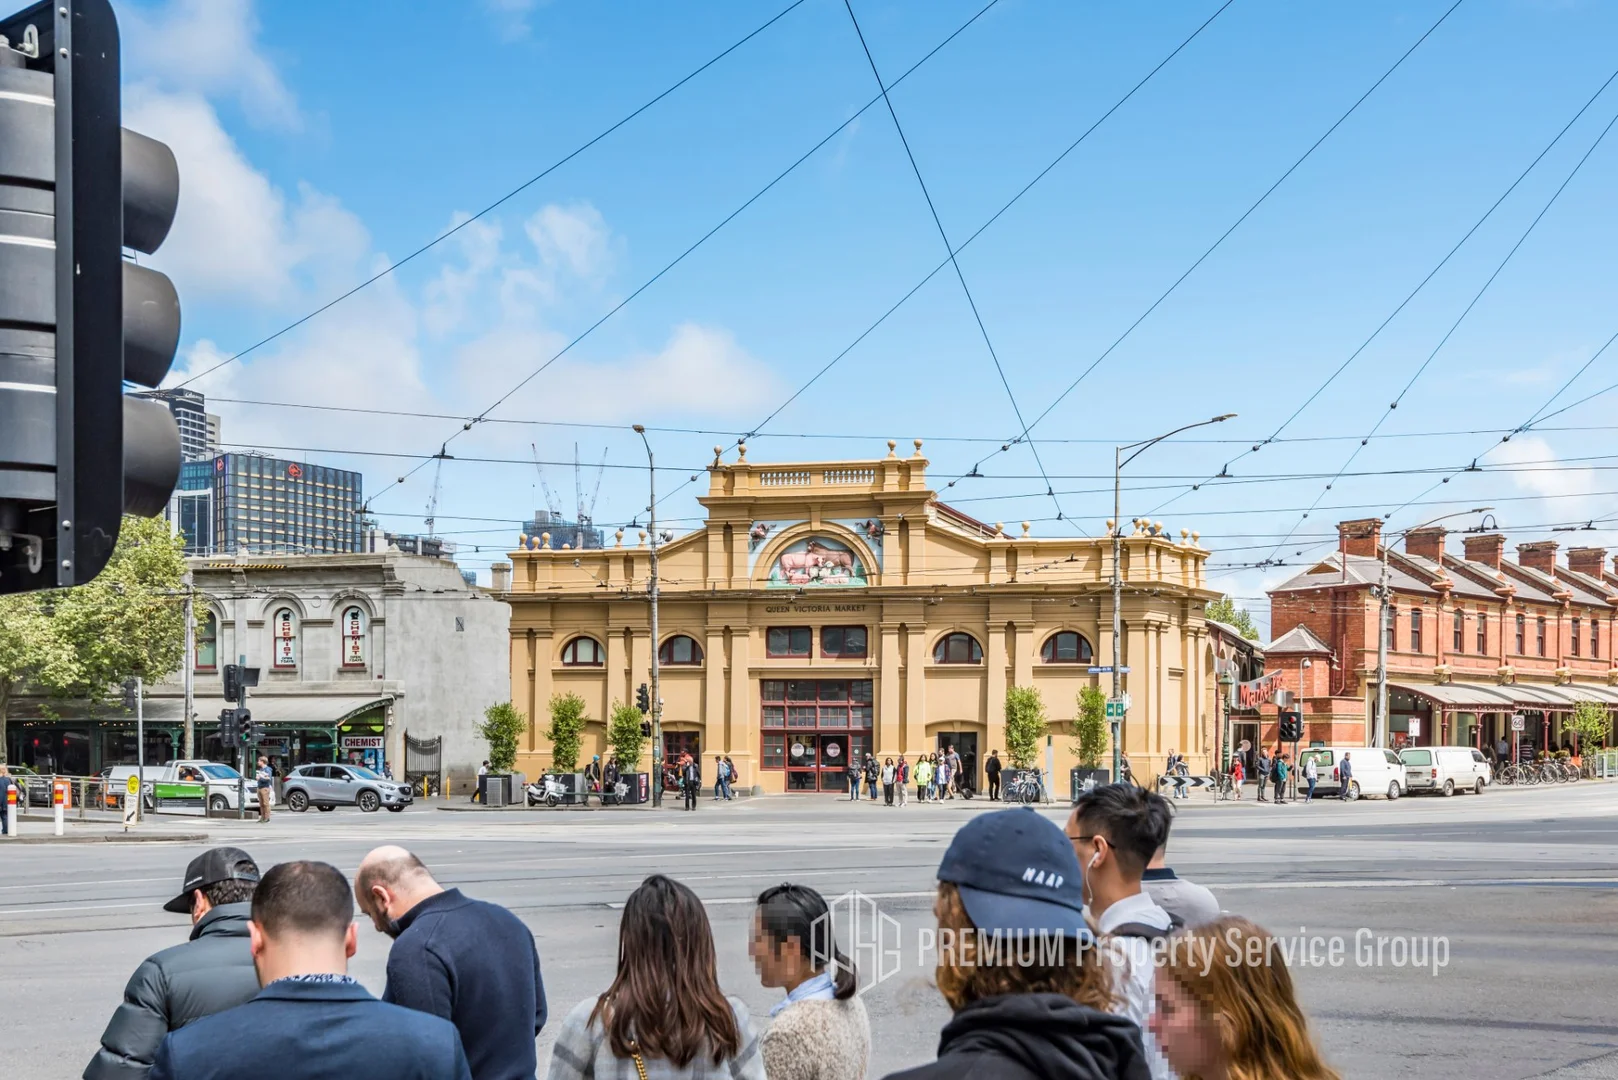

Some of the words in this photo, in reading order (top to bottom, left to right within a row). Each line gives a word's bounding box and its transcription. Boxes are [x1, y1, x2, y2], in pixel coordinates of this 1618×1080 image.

[794, 605, 831, 613] VICTORIA
[834, 604, 866, 612] MARKET
[282, 621, 291, 656] CHEMIST
[351, 620, 360, 655] CHEMIST
[344, 738, 382, 747] CHEMIST
